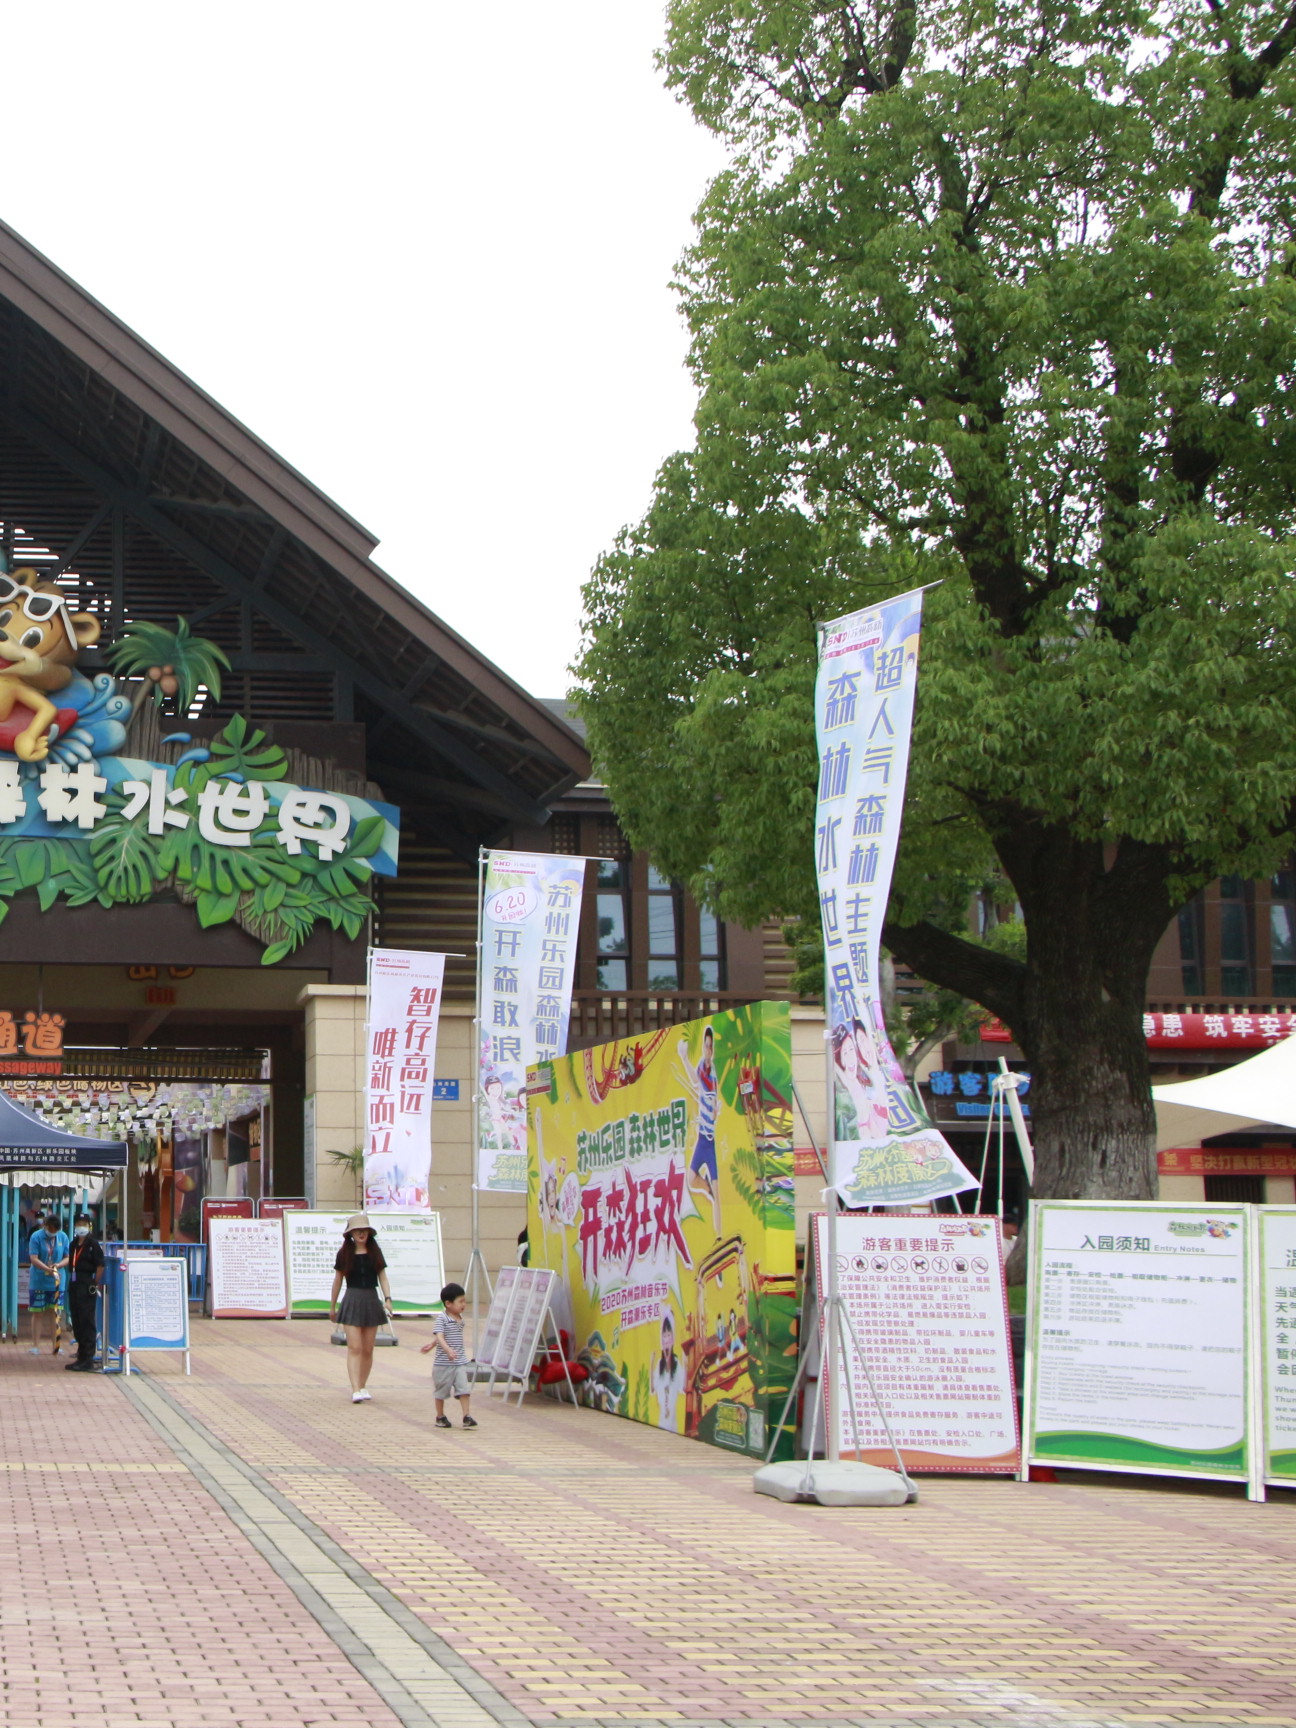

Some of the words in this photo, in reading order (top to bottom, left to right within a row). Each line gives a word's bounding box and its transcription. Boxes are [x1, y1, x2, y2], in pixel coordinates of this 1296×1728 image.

[494, 892, 526, 914] 6.20
[492, 929, 522, 1063] 开森敢浪
[368, 1028, 399, 1155] 唯新而立
[399, 986, 437, 1115] 智存高远
[577, 1119, 626, 1173] 苏州乐园
[629, 1099, 687, 1158] 森林世界
[580, 1158, 692, 1282] 开森狂欢
[862, 1237, 955, 1252] 游客重要提示
[1080, 1235, 1150, 1251] 入园须知
[1154, 1244, 1178, 1253] Entry
